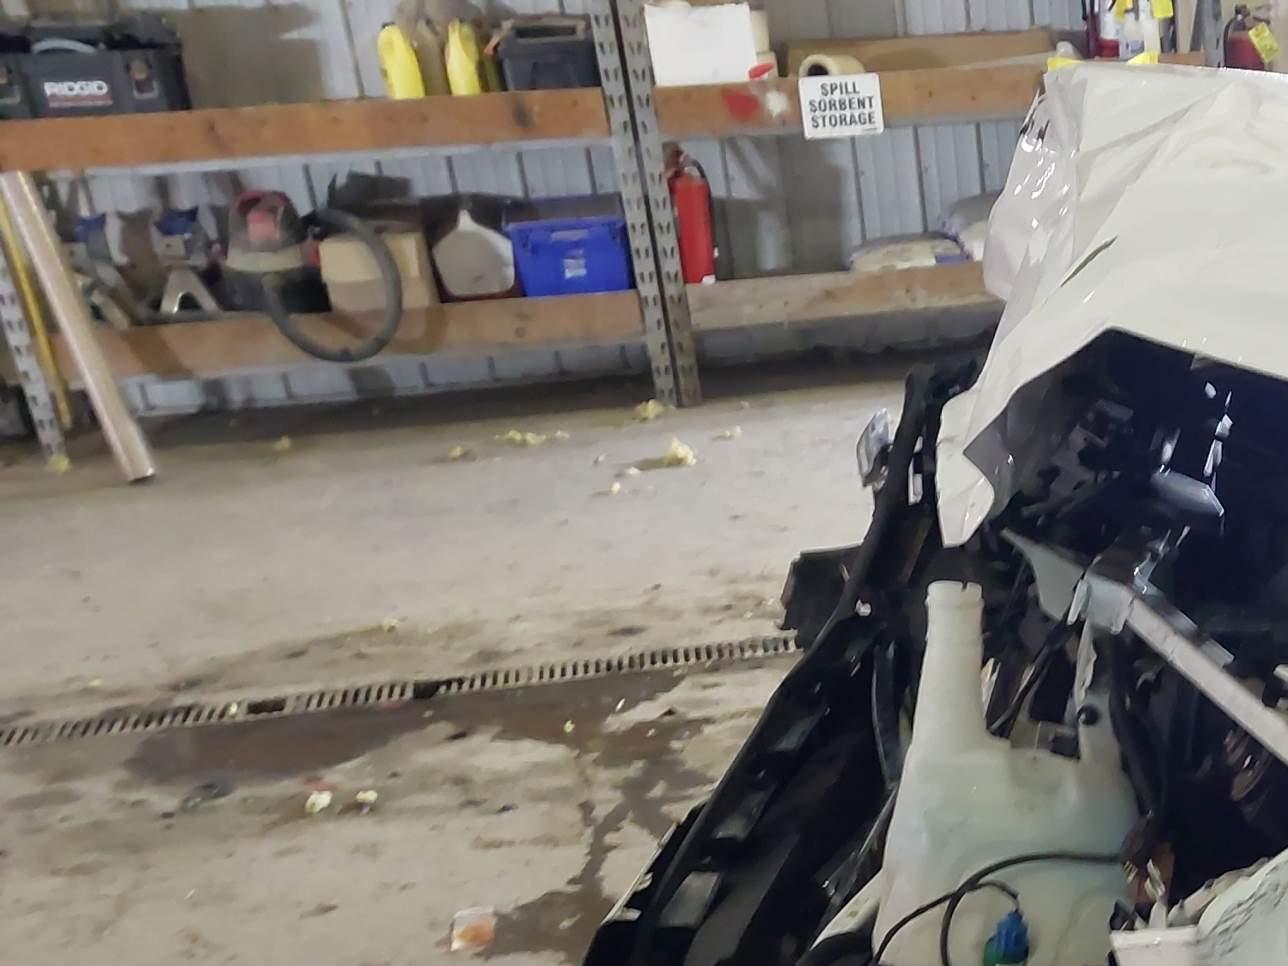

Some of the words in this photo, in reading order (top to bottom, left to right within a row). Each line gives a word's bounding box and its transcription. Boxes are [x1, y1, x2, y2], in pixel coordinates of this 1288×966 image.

[820, 81, 860, 96] SPILL
[809, 96, 874, 113] SORBENT
[811, 112, 876, 128] STORAGE
